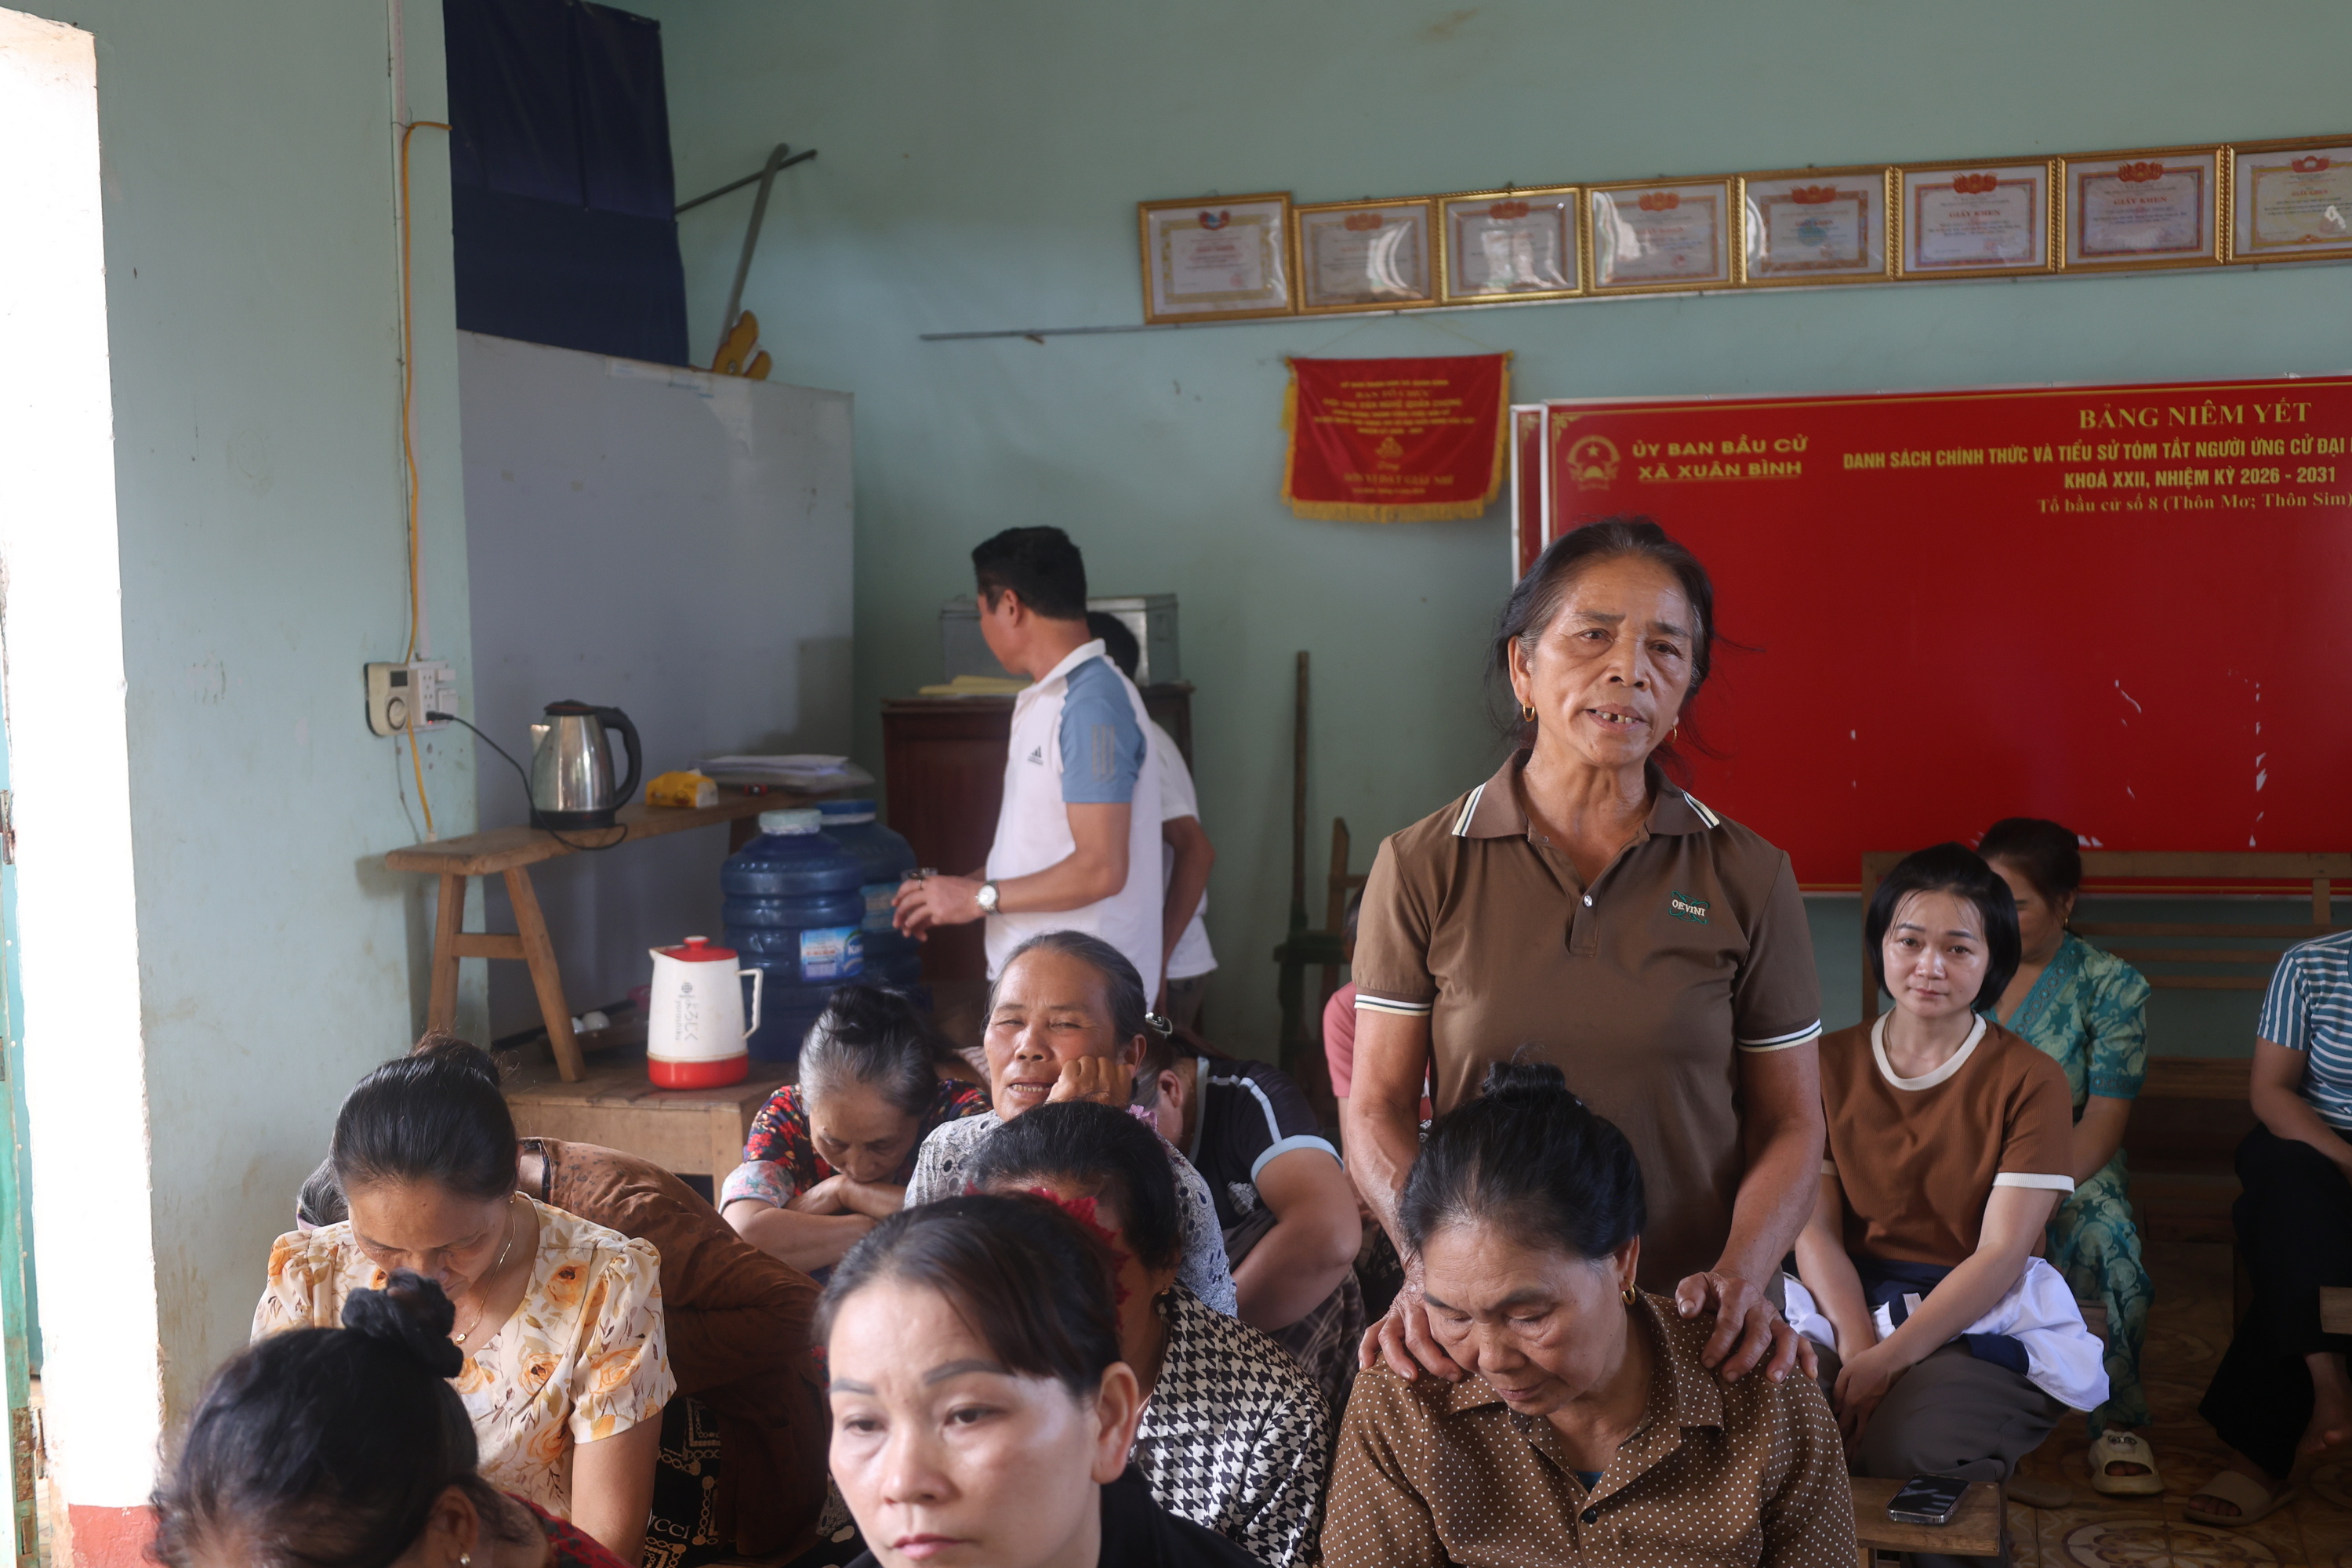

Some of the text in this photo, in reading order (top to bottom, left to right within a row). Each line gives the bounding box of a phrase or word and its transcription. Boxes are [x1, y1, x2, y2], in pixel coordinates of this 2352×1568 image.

[2080, 397, 2312, 428] BẢNG NIÊM YẾT
[1632, 433, 1809, 458] ỦY BAN BẦU CỬ
[1844, 452, 1886, 469] DANH
[1890, 448, 1931, 468] SÁCH
[1936, 445, 1984, 466] CHÍNH
[1988, 444, 2028, 464] THỨC
[2033, 443, 2053, 463] VÀ
[2058, 438, 2092, 462] TIỂU
[2097, 438, 2120, 461] SỬ
[2123, 440, 2158, 460] TÓM
[2162, 436, 2190, 459] TẮT
[2196, 436, 2246, 458] NGƯỜI
[2251, 437, 2285, 456] ỨNG
[2290, 432, 2314, 455] CỬ
[2317, 437, 2345, 458] ĐẠI
[1639, 459, 1802, 480] XÃ XUÂN BÌNH
[2064, 469, 2109, 488] KHOÁ
[2112, 470, 2151, 489] XXII,
[2155, 466, 2209, 490] NHIỆM
[2214, 465, 2235, 485] KỲ
[2240, 466, 2280, 485] 2026
[2296, 466, 2336, 484] 2031
[2038, 495, 2060, 514] Tổ
[2065, 493, 2096, 512] bầu
[2100, 496, 2122, 512] cử
[2126, 492, 2143, 511] số
[2148, 495, 2158, 510] 8
[2163, 495, 2215, 514] (Thôn
[2261, 492, 2307, 507] Thôn
[1671, 899, 1706, 916] OEVINI
[684, 1000, 699, 1041] よろしく
